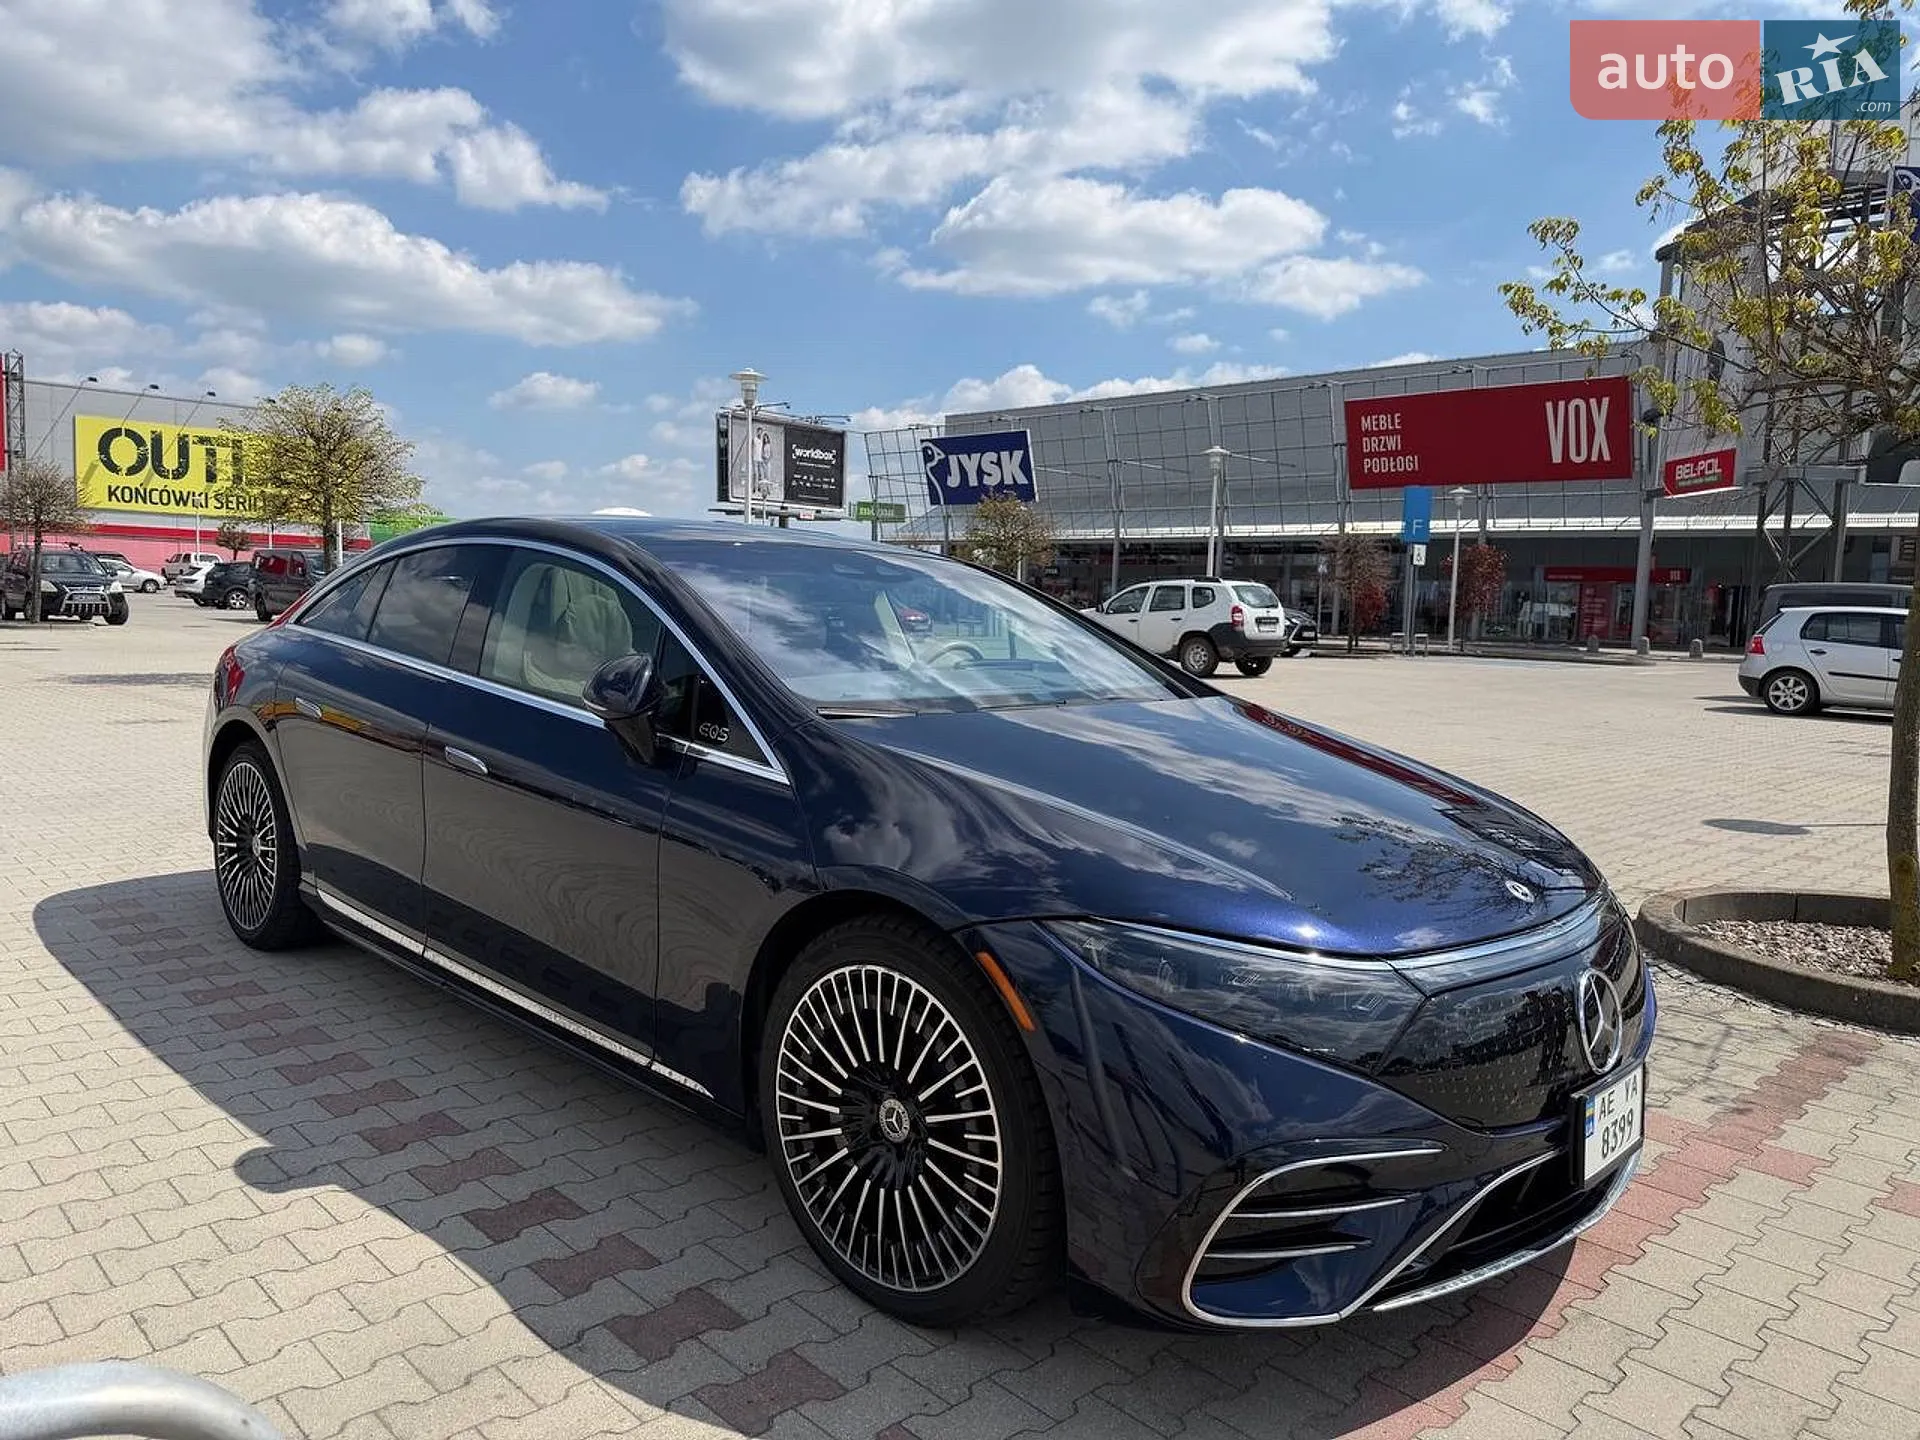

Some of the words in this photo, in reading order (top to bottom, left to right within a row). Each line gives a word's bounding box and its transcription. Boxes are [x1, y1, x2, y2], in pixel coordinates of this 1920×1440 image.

[1361, 413, 1402, 432] MEBLE
[1545, 397, 1611, 463] VOX
[1362, 434, 1401, 453] DRZWI
[947, 450, 1028, 488] JYSK
[1364, 455, 1418, 474] PODŁOGI
[108, 483, 208, 508] KOŃCÓWKI
[1412, 519, 1424, 537] F
[1599, 1089, 1615, 1120] AE
[1602, 1107, 1633, 1159] 8399
